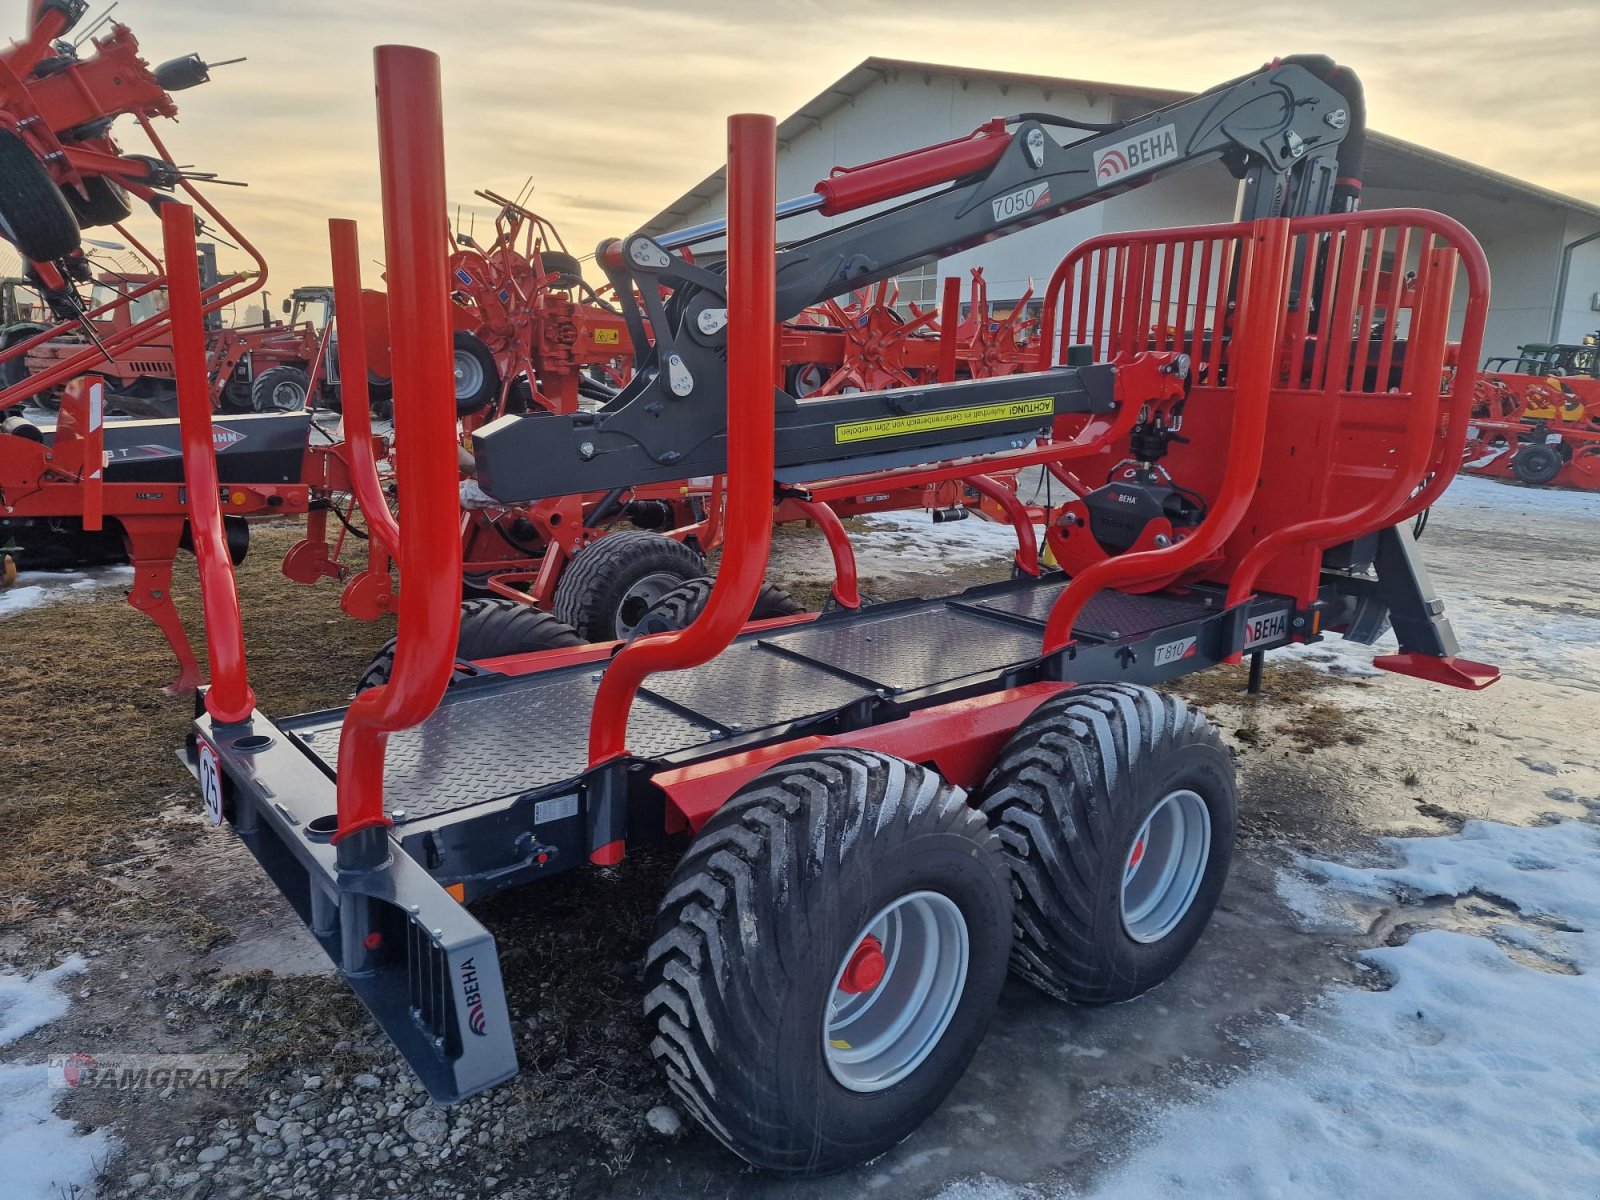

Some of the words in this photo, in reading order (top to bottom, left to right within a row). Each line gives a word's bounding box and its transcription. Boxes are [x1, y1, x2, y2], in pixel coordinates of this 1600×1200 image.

[1127, 131, 1175, 168] BEHA
[993, 189, 1035, 219] 7050
[1009, 401, 1051, 415] ACHTUNG!
[841, 426, 873, 436] verboten
[1118, 494, 1136, 504] BEHA
[1253, 615, 1285, 641] BEHA
[1156, 648, 1164, 661] T
[1165, 642, 1184, 660] 810
[203, 758, 218, 815] 25
[460, 956, 482, 1008] BEHA
